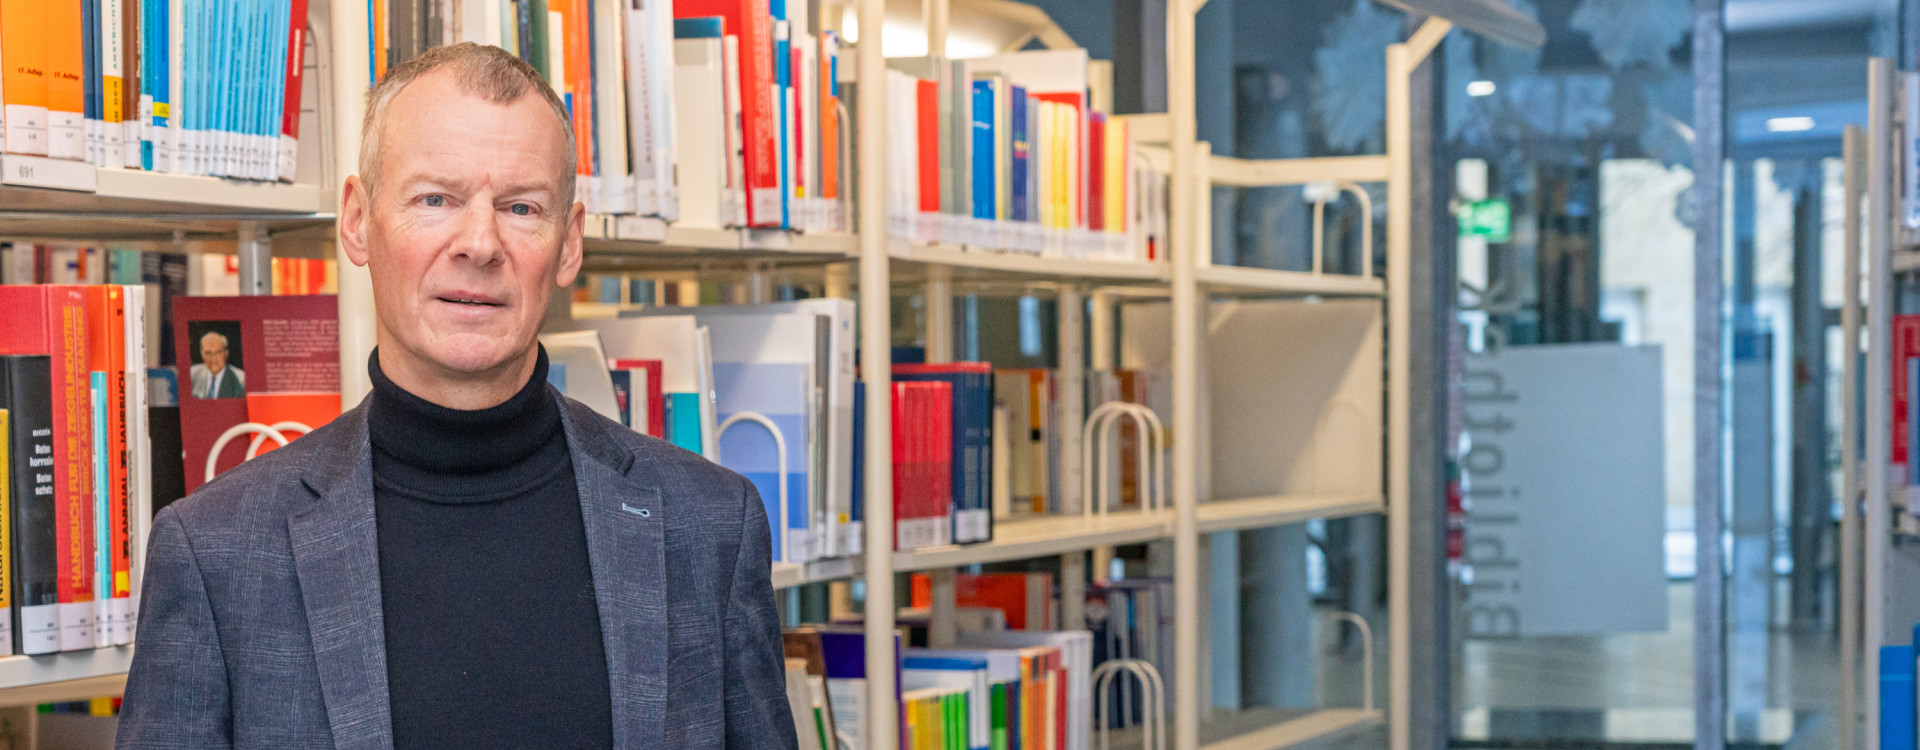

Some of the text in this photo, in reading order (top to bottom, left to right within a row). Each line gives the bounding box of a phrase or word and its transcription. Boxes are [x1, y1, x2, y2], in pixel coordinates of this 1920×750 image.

[19, 166, 34, 179] 691
[63, 305, 76, 433] ZIEGELINDUSTRIE
[76, 306, 90, 495] BRICK AND TILE MAKING
[67, 436, 78, 461] DIE
[70, 496, 82, 588] HANDBUCH
